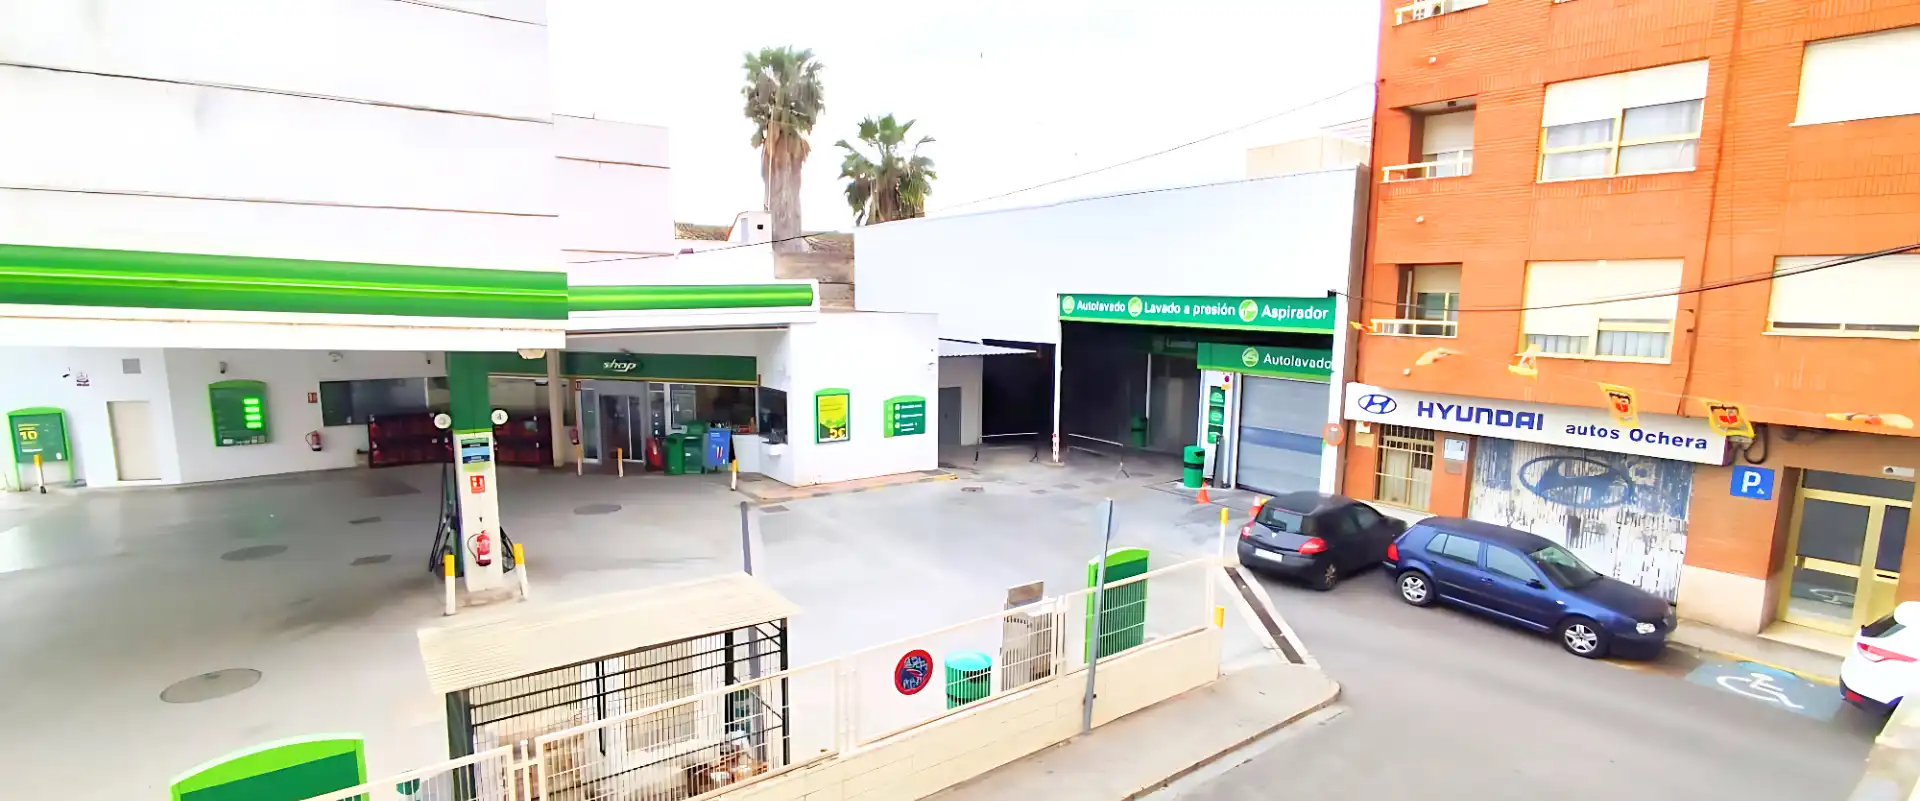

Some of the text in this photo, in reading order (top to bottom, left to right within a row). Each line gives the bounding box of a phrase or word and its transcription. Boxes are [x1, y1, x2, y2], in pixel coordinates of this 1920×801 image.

[1077, 300, 1329, 321] Autolavado Lavado a presión Aspirador
[603, 358, 637, 373] shop
[1263, 353, 1332, 369] Autolavado
[1417, 401, 1544, 431] HYUNDAI
[1565, 423, 1707, 450] autos Ochera
[1741, 470, 1762, 493] P
